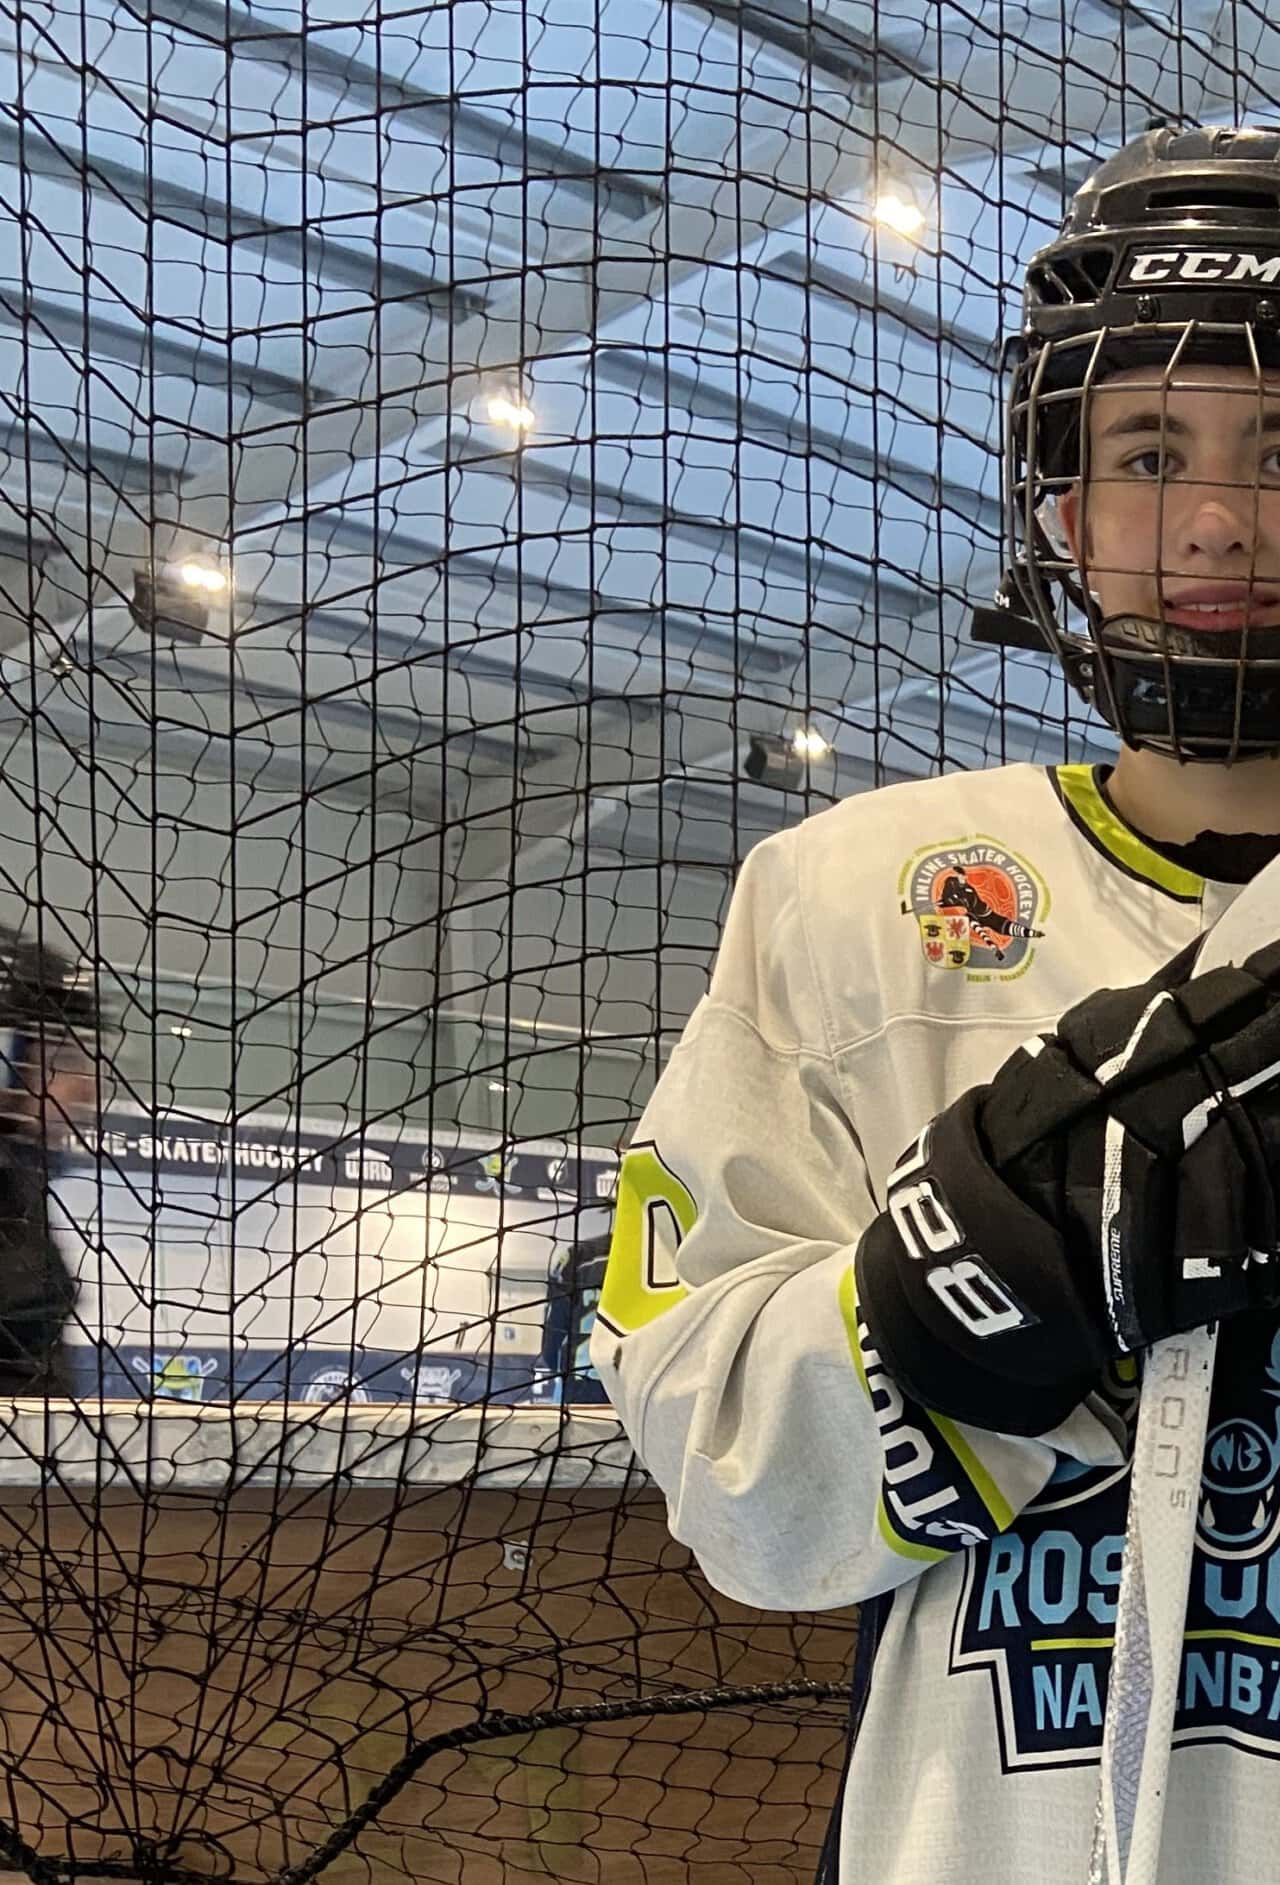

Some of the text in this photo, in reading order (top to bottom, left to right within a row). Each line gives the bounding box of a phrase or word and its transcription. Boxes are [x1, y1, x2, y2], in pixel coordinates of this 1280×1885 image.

[915, 857, 947, 901] INLINE
[948, 849, 1006, 865] SKATER
[1005, 864, 1034, 921] HOCKEY
[1110, 1227, 1125, 1305] SUPREME
[1210, 1431, 1262, 1472] NB
